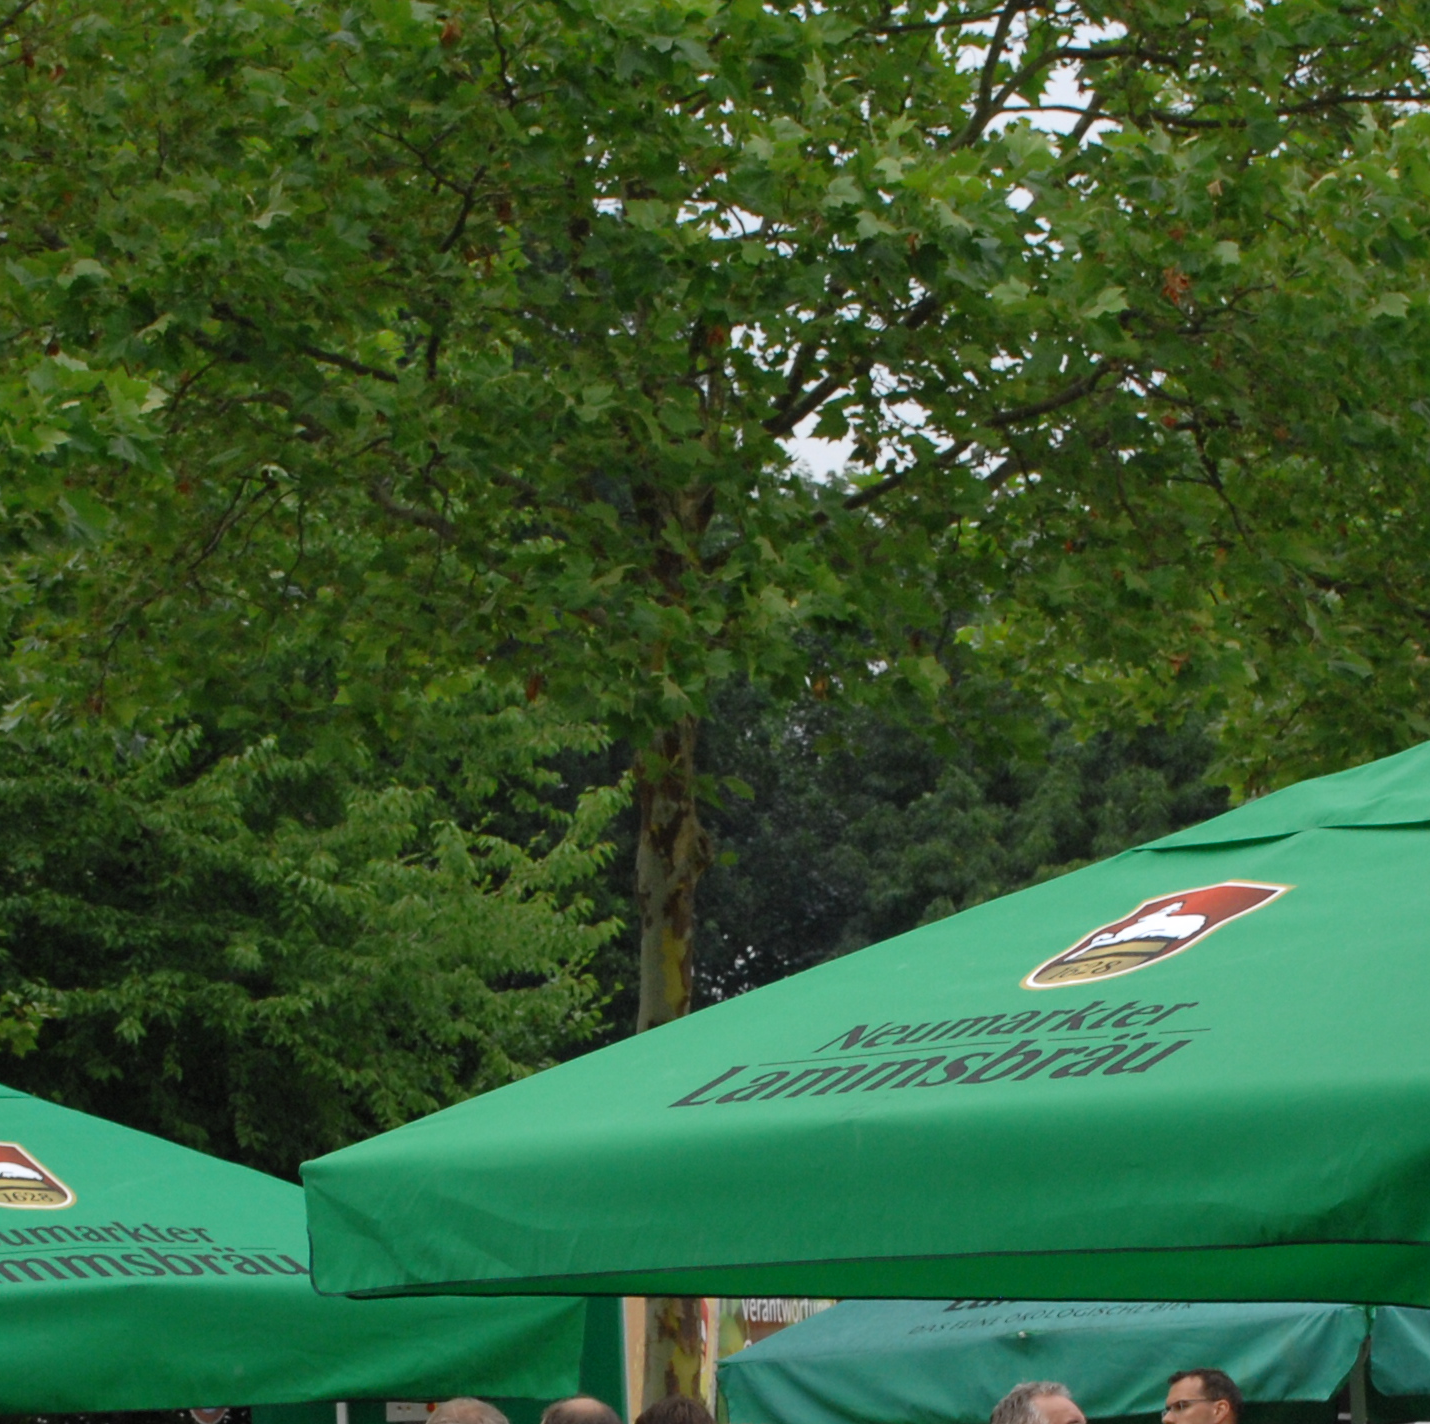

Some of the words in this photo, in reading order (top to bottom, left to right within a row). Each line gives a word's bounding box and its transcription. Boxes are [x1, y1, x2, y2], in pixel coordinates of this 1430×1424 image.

[813, 1000, 1200, 1053] Neumarkter
[668, 1033, 1194, 1108] Lammsbräu
[2, 1192, 54, 1203] 1628
